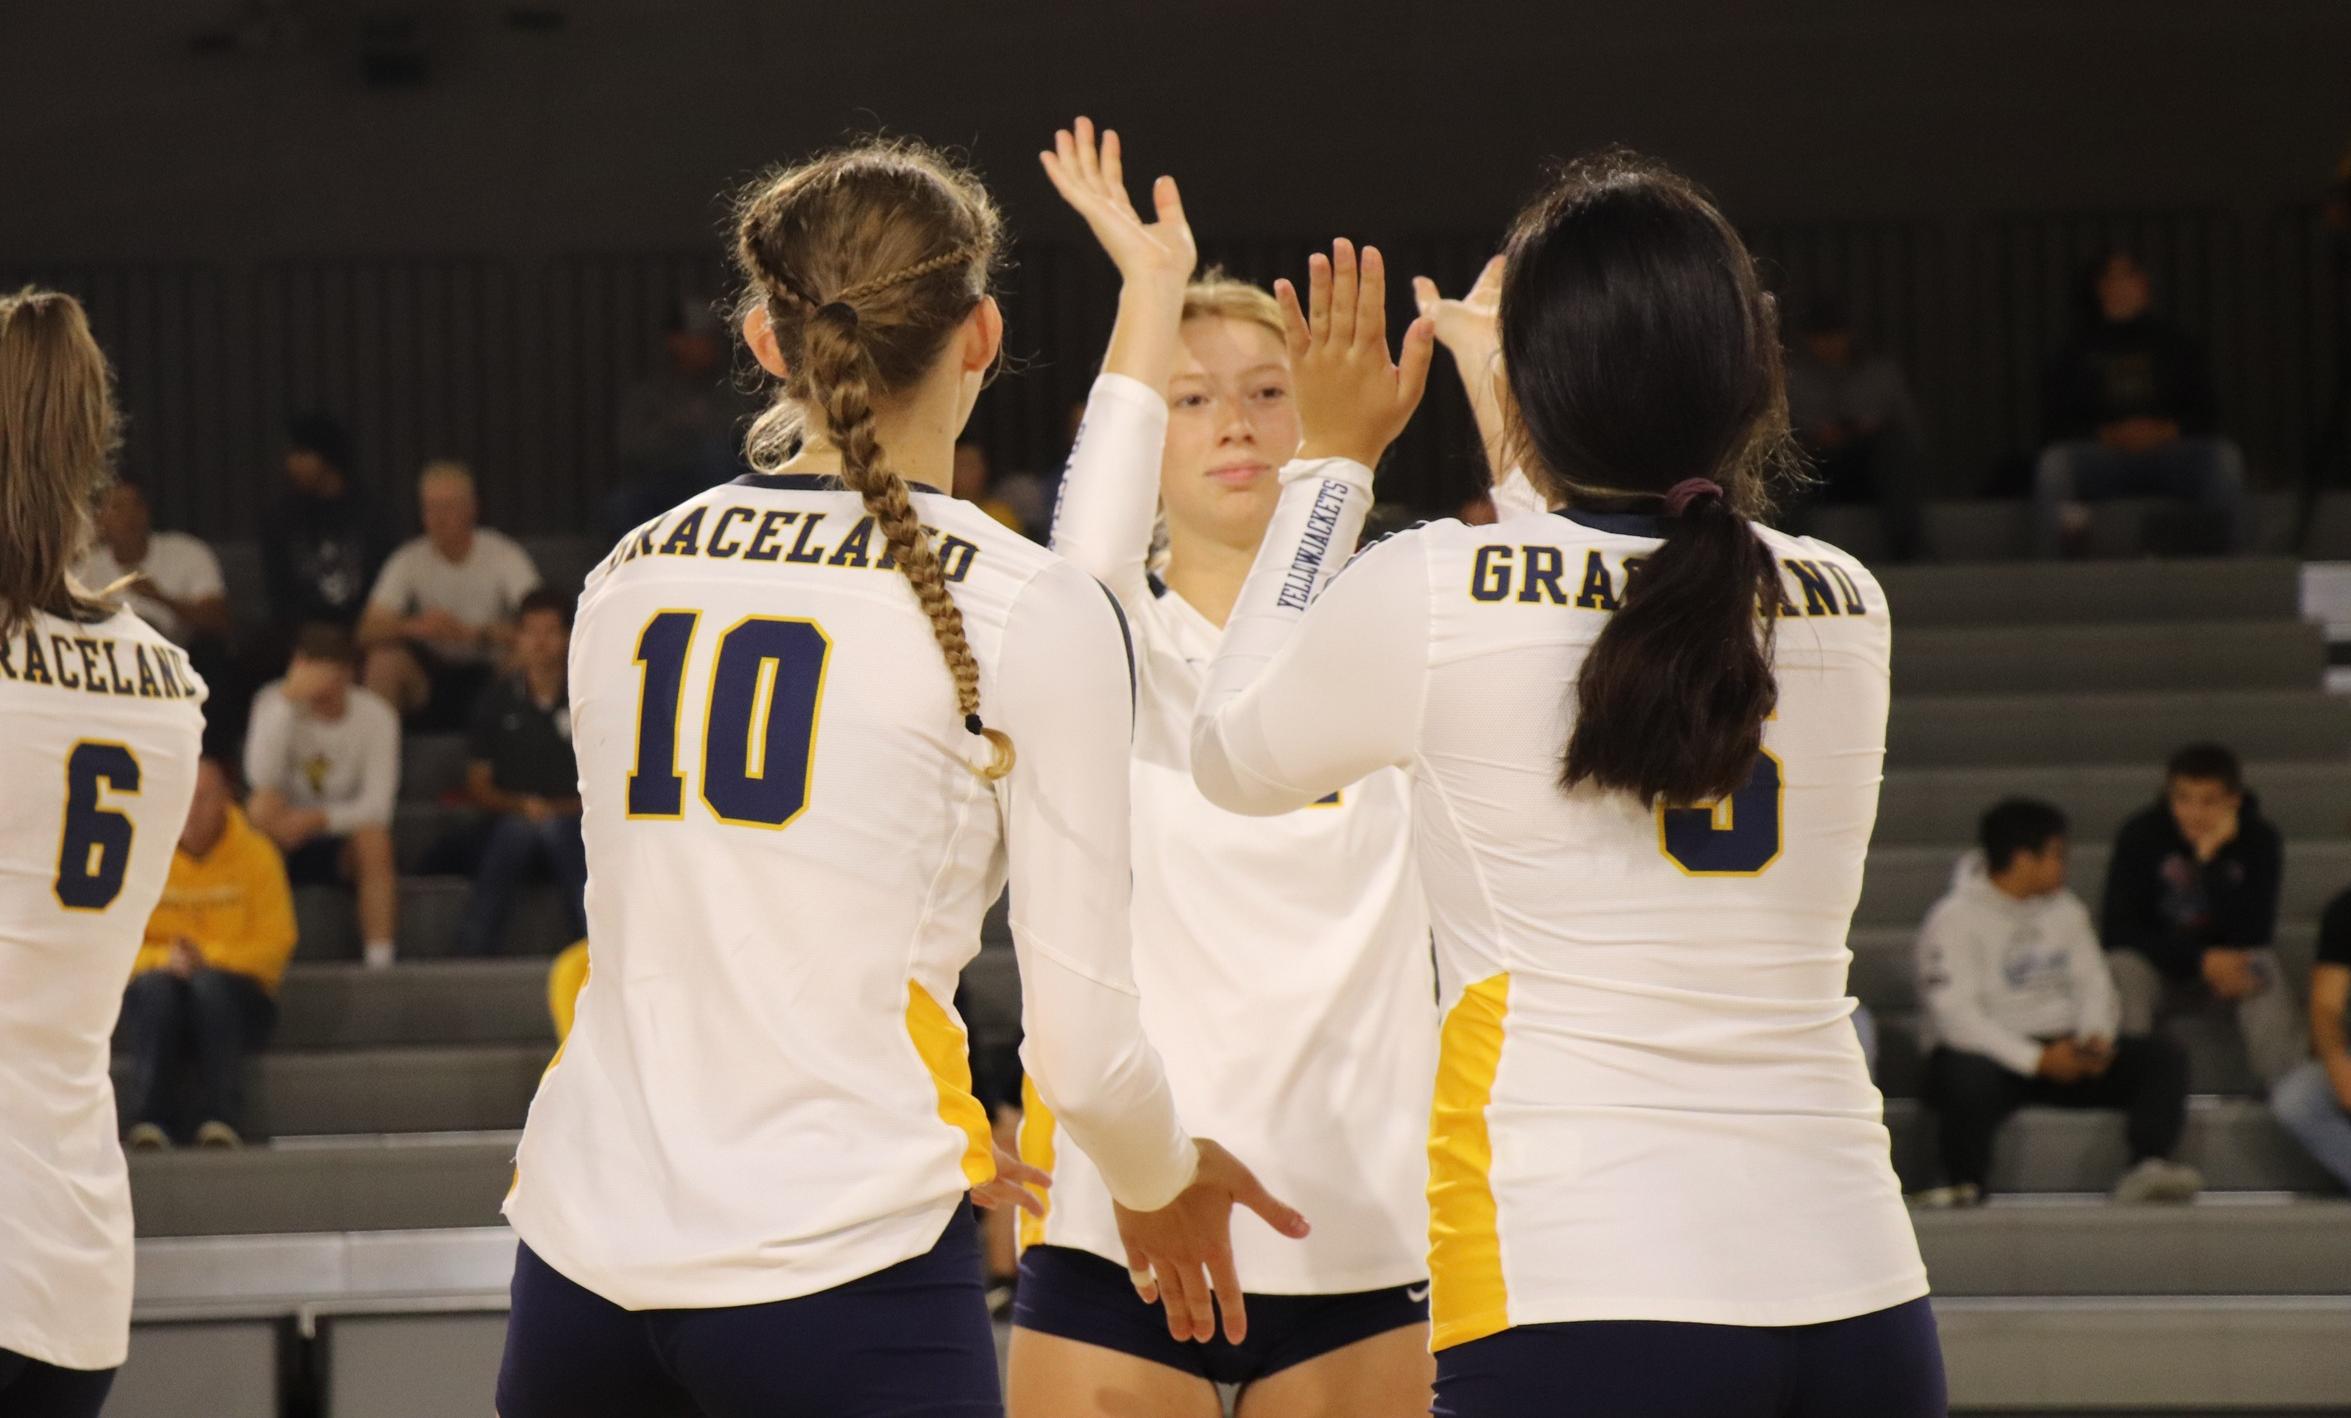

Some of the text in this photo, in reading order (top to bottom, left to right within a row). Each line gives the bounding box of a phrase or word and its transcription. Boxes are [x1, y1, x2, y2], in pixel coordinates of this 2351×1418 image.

[604, 504, 981, 584] RACELAD
[1276, 479, 1349, 612] YELLOWJACKETS
[1470, 543, 1867, 618] GRAND
[625, 608, 834, 832] 10
[53, 736, 143, 915] 6
